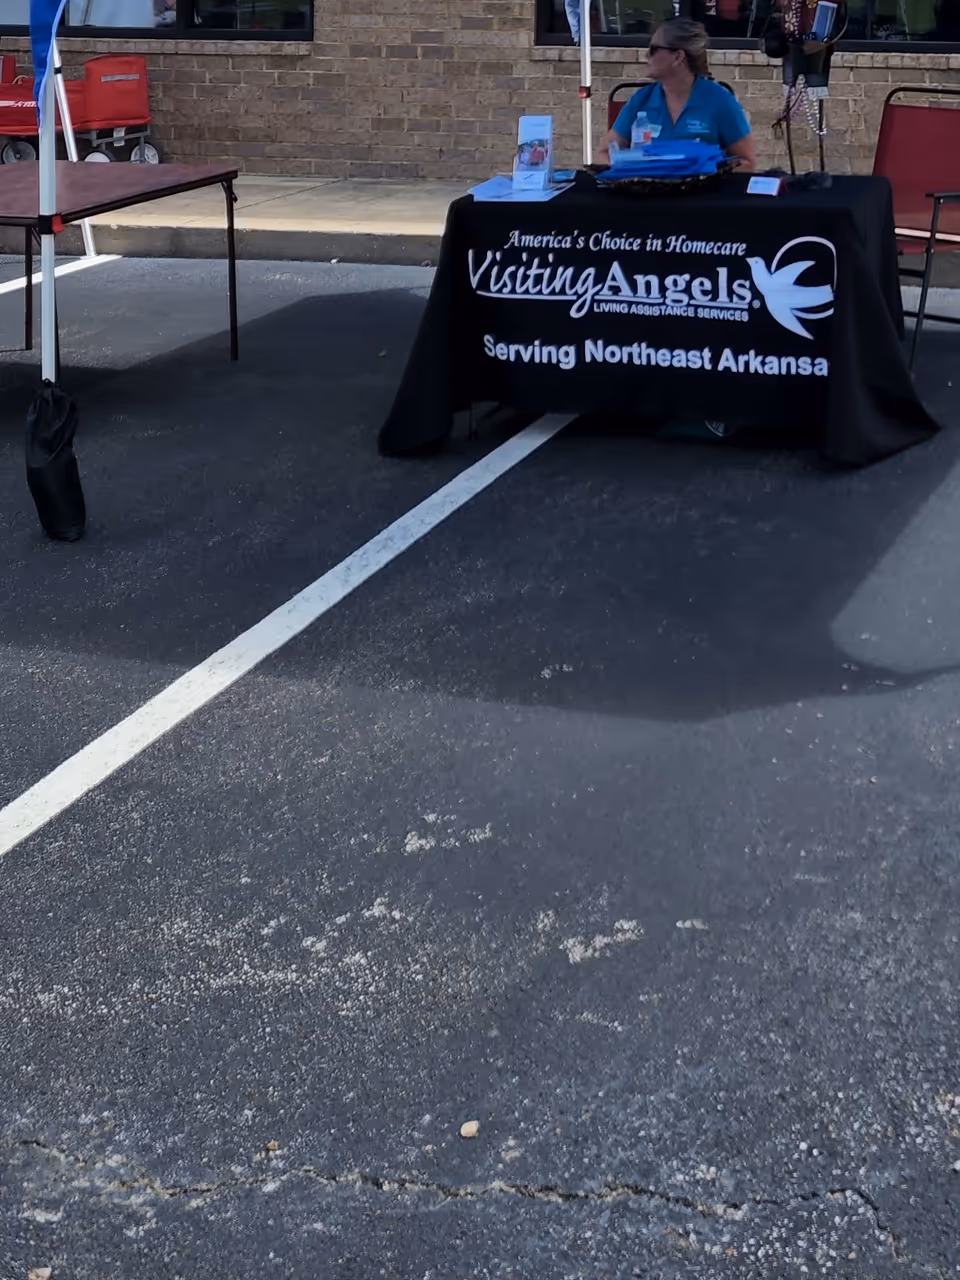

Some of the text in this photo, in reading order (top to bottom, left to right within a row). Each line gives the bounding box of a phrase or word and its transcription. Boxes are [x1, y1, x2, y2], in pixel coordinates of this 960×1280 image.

[503, 230, 747, 256] America's Choice in Homecare
[468, 248, 753, 318] Visiting Angels
[594, 302, 749, 322] LIVING ASSISTANCE SERVICES
[483, 334, 829, 376] Serving Northeast Arkansa
